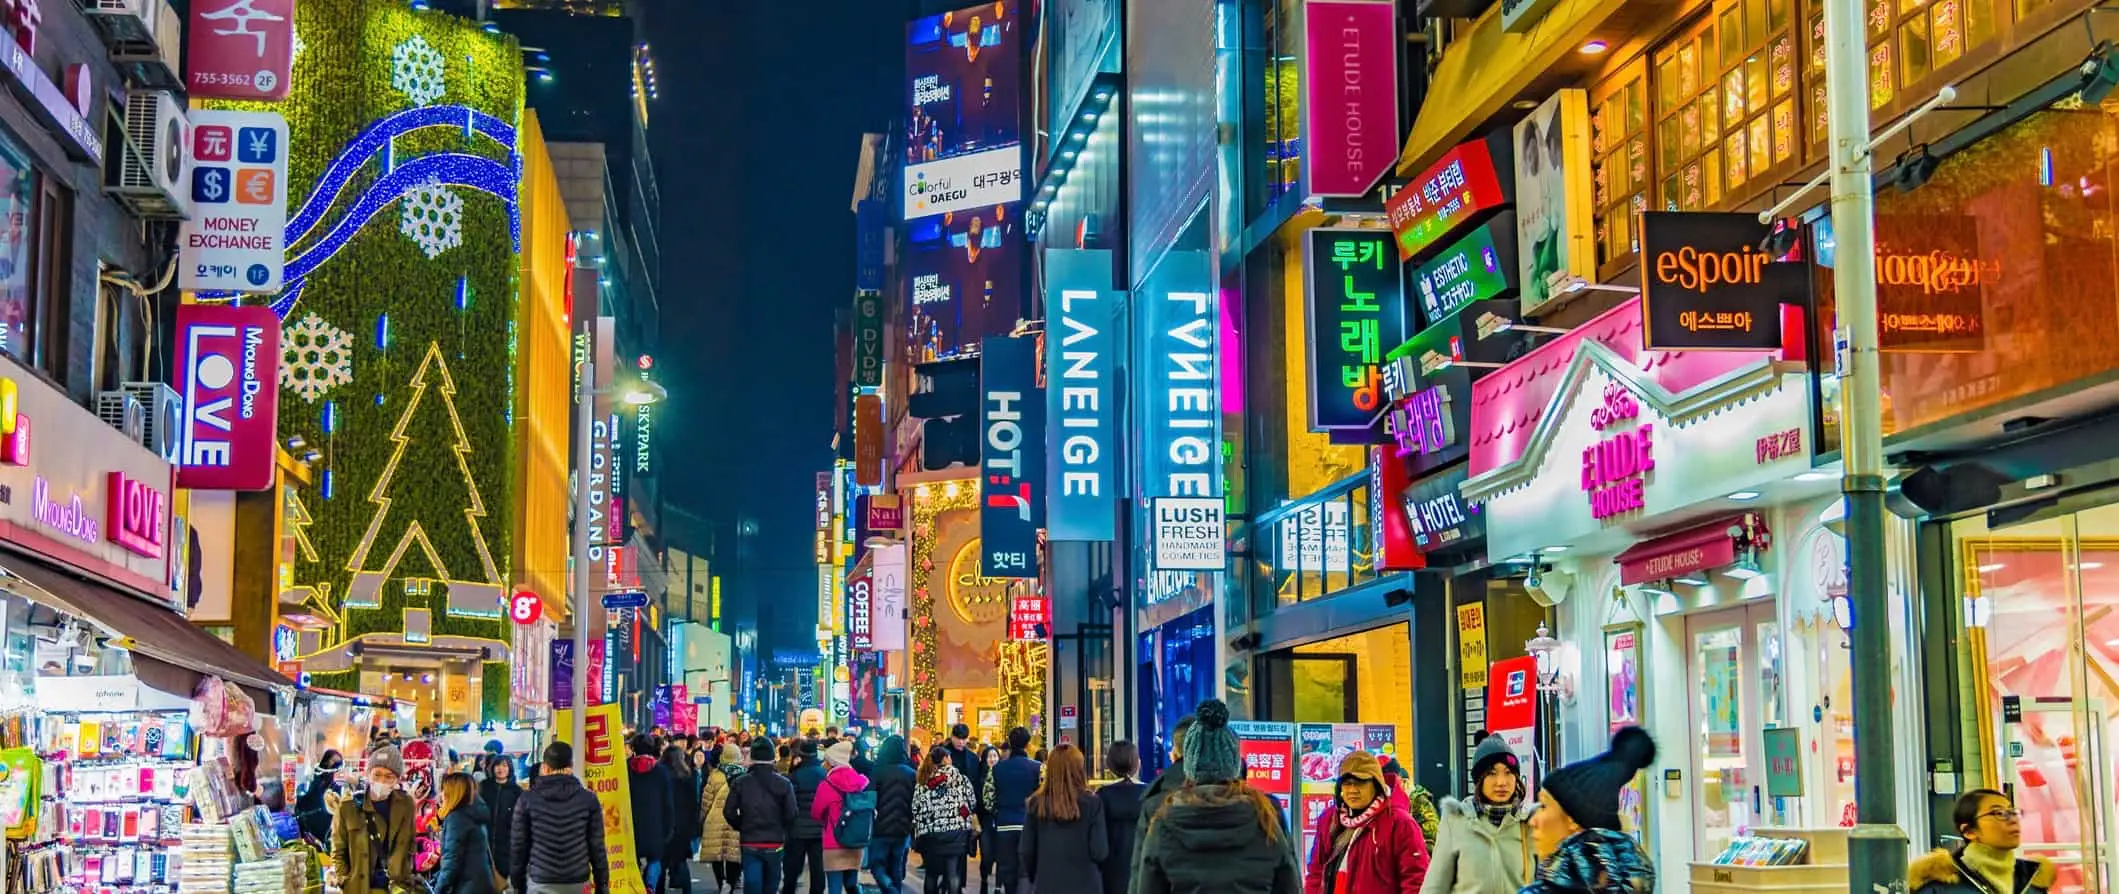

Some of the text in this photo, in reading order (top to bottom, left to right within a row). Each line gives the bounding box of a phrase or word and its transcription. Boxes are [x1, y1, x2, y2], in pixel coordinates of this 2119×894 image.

[194, 72, 274, 87] 755-3562 2F
[1343, 28, 1364, 171] ETUDE HOUSE
[203, 131, 227, 155] 元
[931, 190, 967, 204] DAEGU
[204, 217, 258, 232] MONEY
[189, 235, 272, 250] EXCHANGE
[1331, 240, 1383, 271] 루키
[195, 264, 237, 278] 오케이
[1432, 252, 1468, 288] ESTHETIC
[1657, 246, 1769, 293] eSpoir
[1680, 312, 1752, 333] 에스쁘아
[1340, 275, 1382, 411] 노래방
[183, 326, 236, 466] LOVE
[1062, 290, 1100, 497] LANEIGE
[637, 405, 650, 472] SKYPARK
[1581, 424, 1655, 490] ETUDE
[589, 420, 608, 561] GIORDANO
[1591, 479, 1644, 519] HOUSE
[110, 471, 164, 558] LOVE
[1161, 508, 1219, 523] LUSH
[1420, 492, 1465, 533] HOTEL
[1162, 527, 1219, 539] FRESH
[1162, 542, 1218, 550] HANDMADE
[992, 552, 1026, 569] 핫티
[1162, 552, 1220, 560] COSMETICS
[1649, 549, 1701, 575] ETUDE HOUSE
[855, 581, 869, 634] COFFEE
[1246, 753, 1285, 768] 美容室
